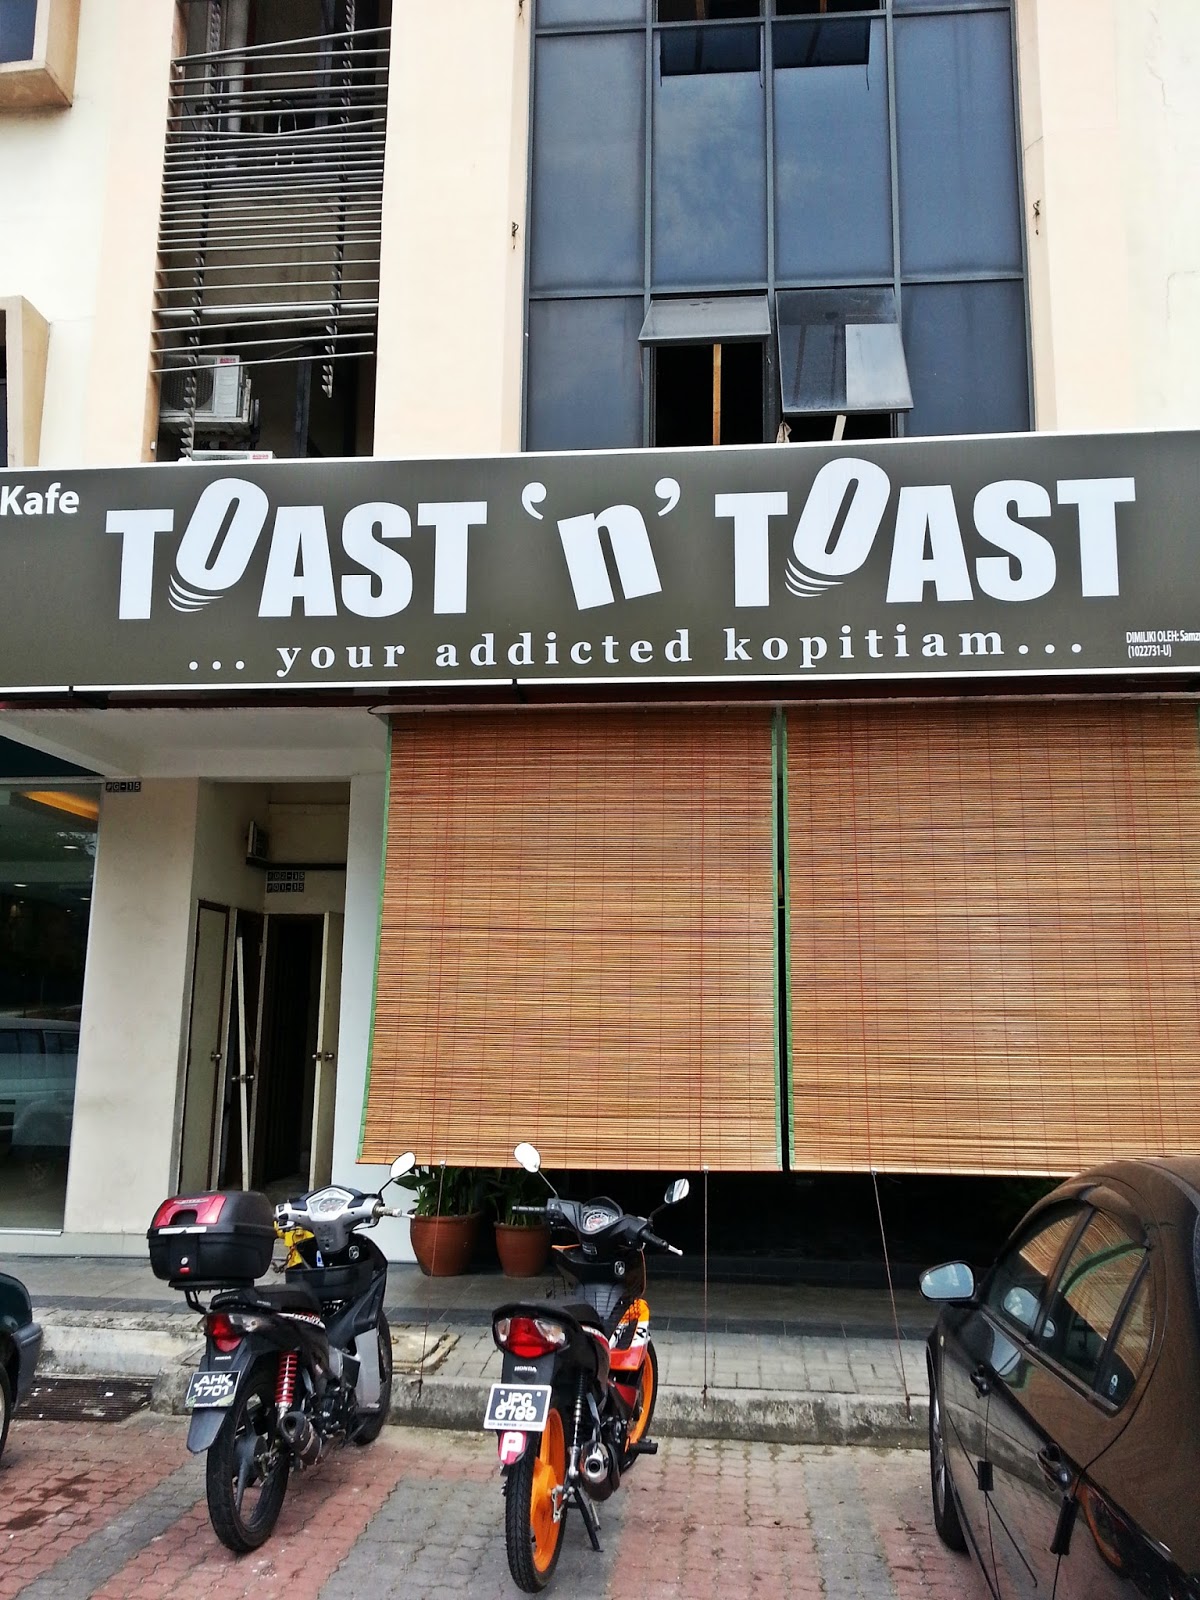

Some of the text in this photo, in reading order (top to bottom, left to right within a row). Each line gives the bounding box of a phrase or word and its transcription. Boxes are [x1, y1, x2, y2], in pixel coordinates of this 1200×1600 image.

[0, 482, 80, 517] Kafe
[105, 478, 488, 620] TOAST
[714, 459, 1137, 608] TOAST
[1125, 630, 1157, 644] DIMILIKI
[1157, 629, 1180, 643] OLEH:
[276, 646, 405, 678] your
[435, 628, 693, 667] addicted
[1127, 643, 1172, 659] (1022731-U)
[199, 1373, 232, 1385] AHK
[195, 1384, 229, 1397] 1701
[500, 1391, 533, 1407] JPG
